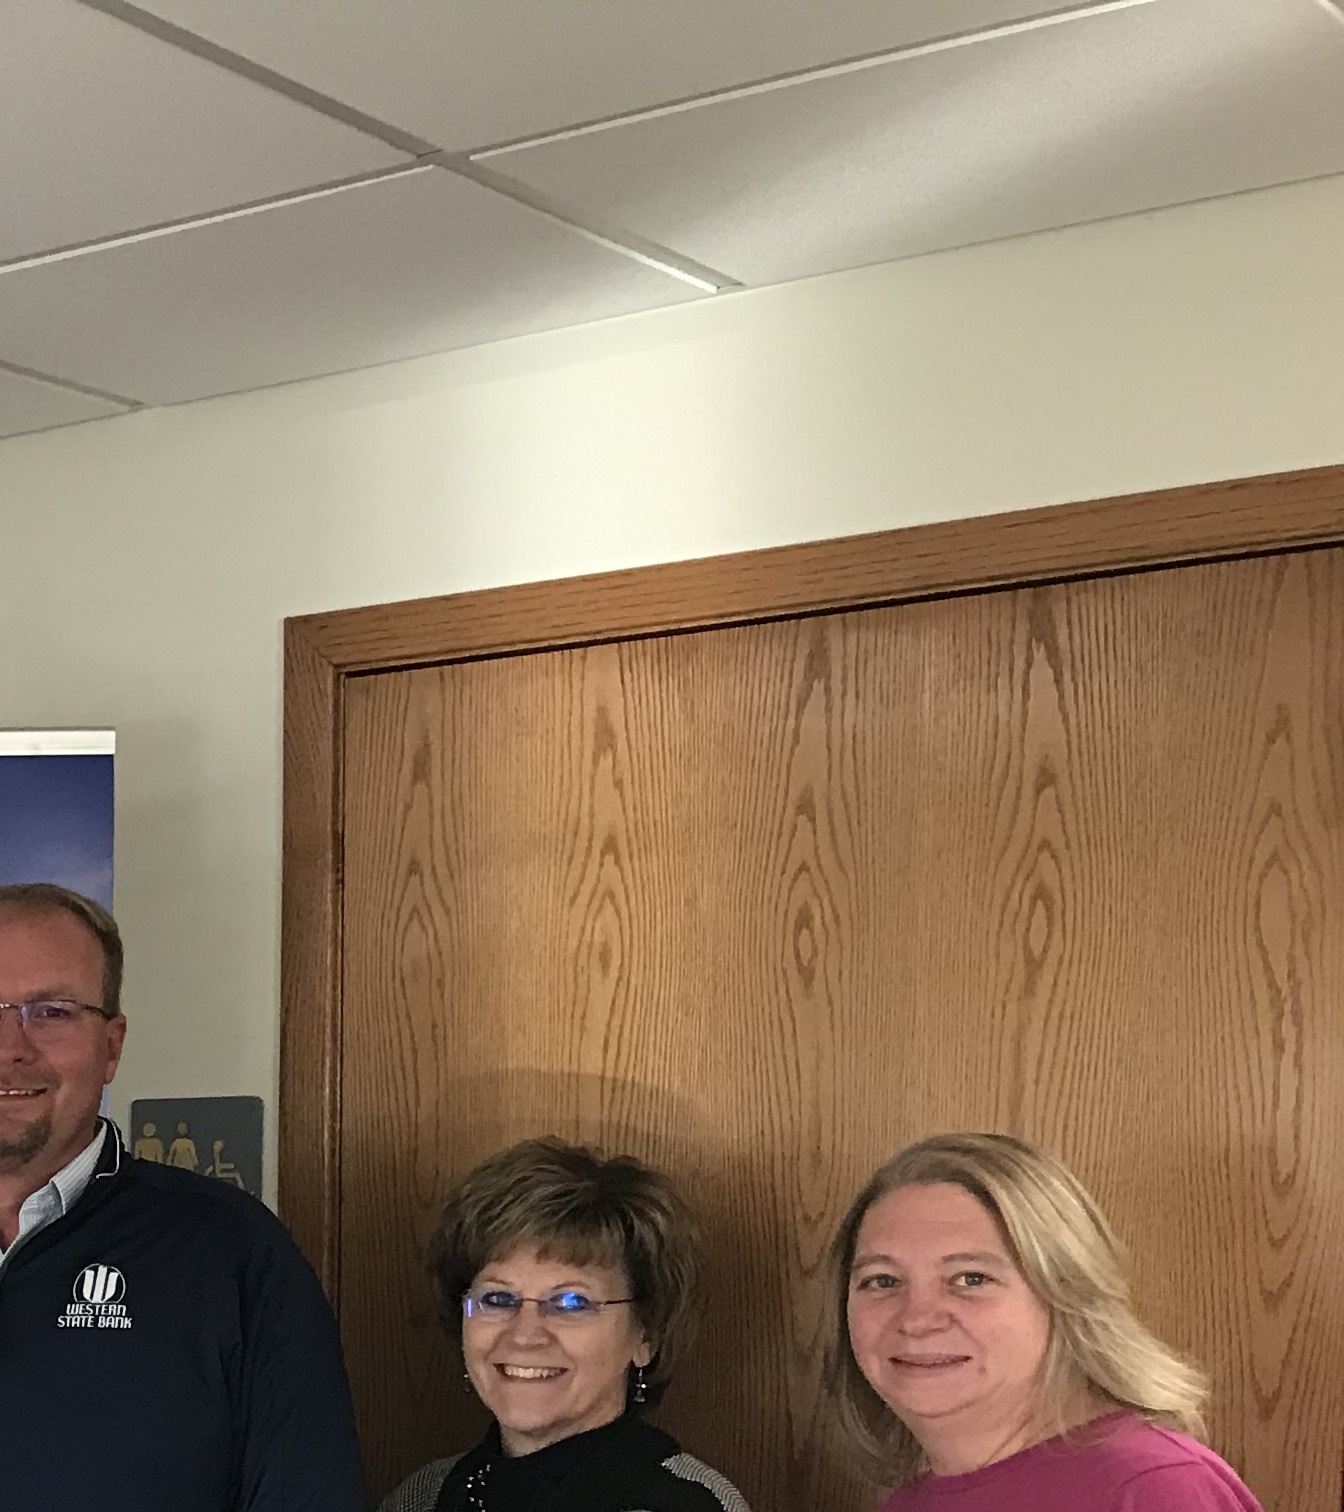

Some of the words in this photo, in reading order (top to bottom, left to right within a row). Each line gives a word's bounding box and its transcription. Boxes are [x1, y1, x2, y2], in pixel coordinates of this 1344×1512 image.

[66, 1303, 126, 1316] WESTERN
[57, 1315, 94, 1327] STATE
[97, 1316, 132, 1329] BANK
